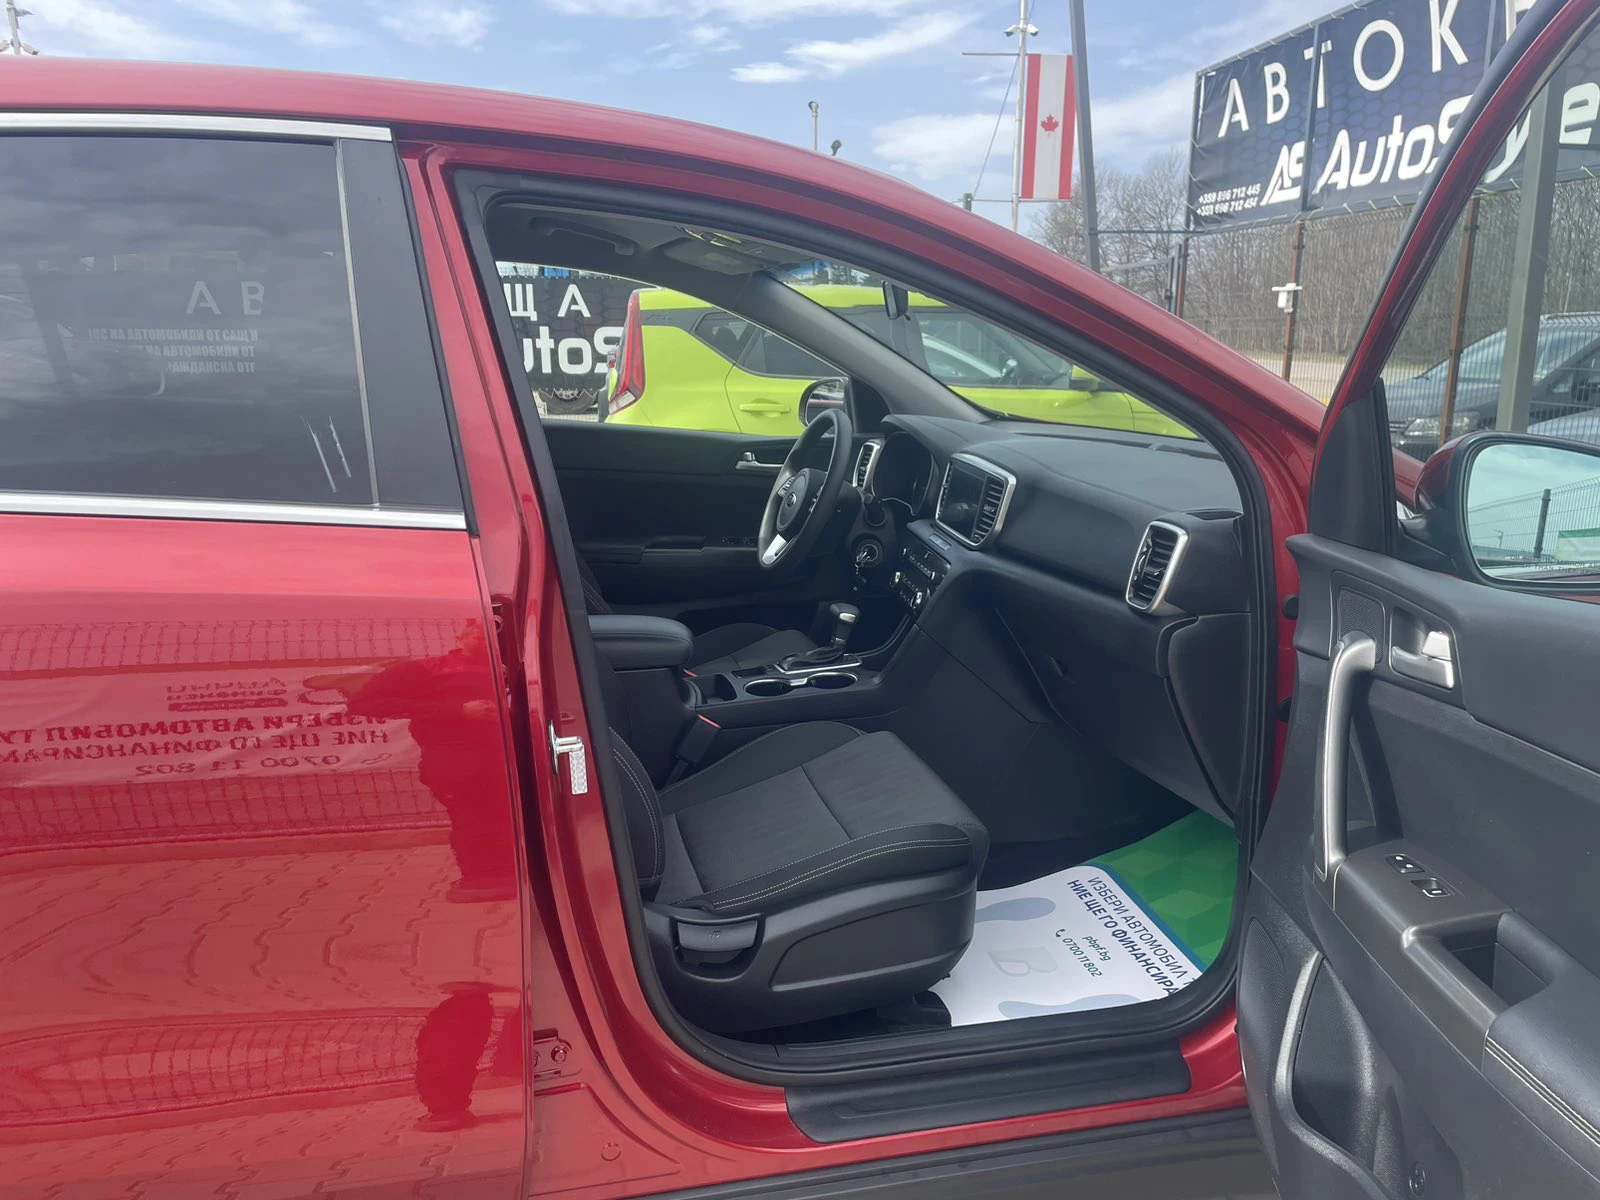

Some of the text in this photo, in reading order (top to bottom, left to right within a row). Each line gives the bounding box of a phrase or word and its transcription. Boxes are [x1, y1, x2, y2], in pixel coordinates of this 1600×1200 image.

[1217, 0, 1537, 139] АВТОК
[1229, 199, 1244, 212] 712
[1232, 186, 1247, 200] 712
[1067, 879, 1094, 901] НИЕ
[1084, 898, 1108, 917] ЩЕ
[1098, 914, 1119, 929] ГО
[1087, 876, 1188, 979] ИЗБЕРИ АВТОМОБИЛ
[1082, 935, 1112, 962] pbpf.bg
